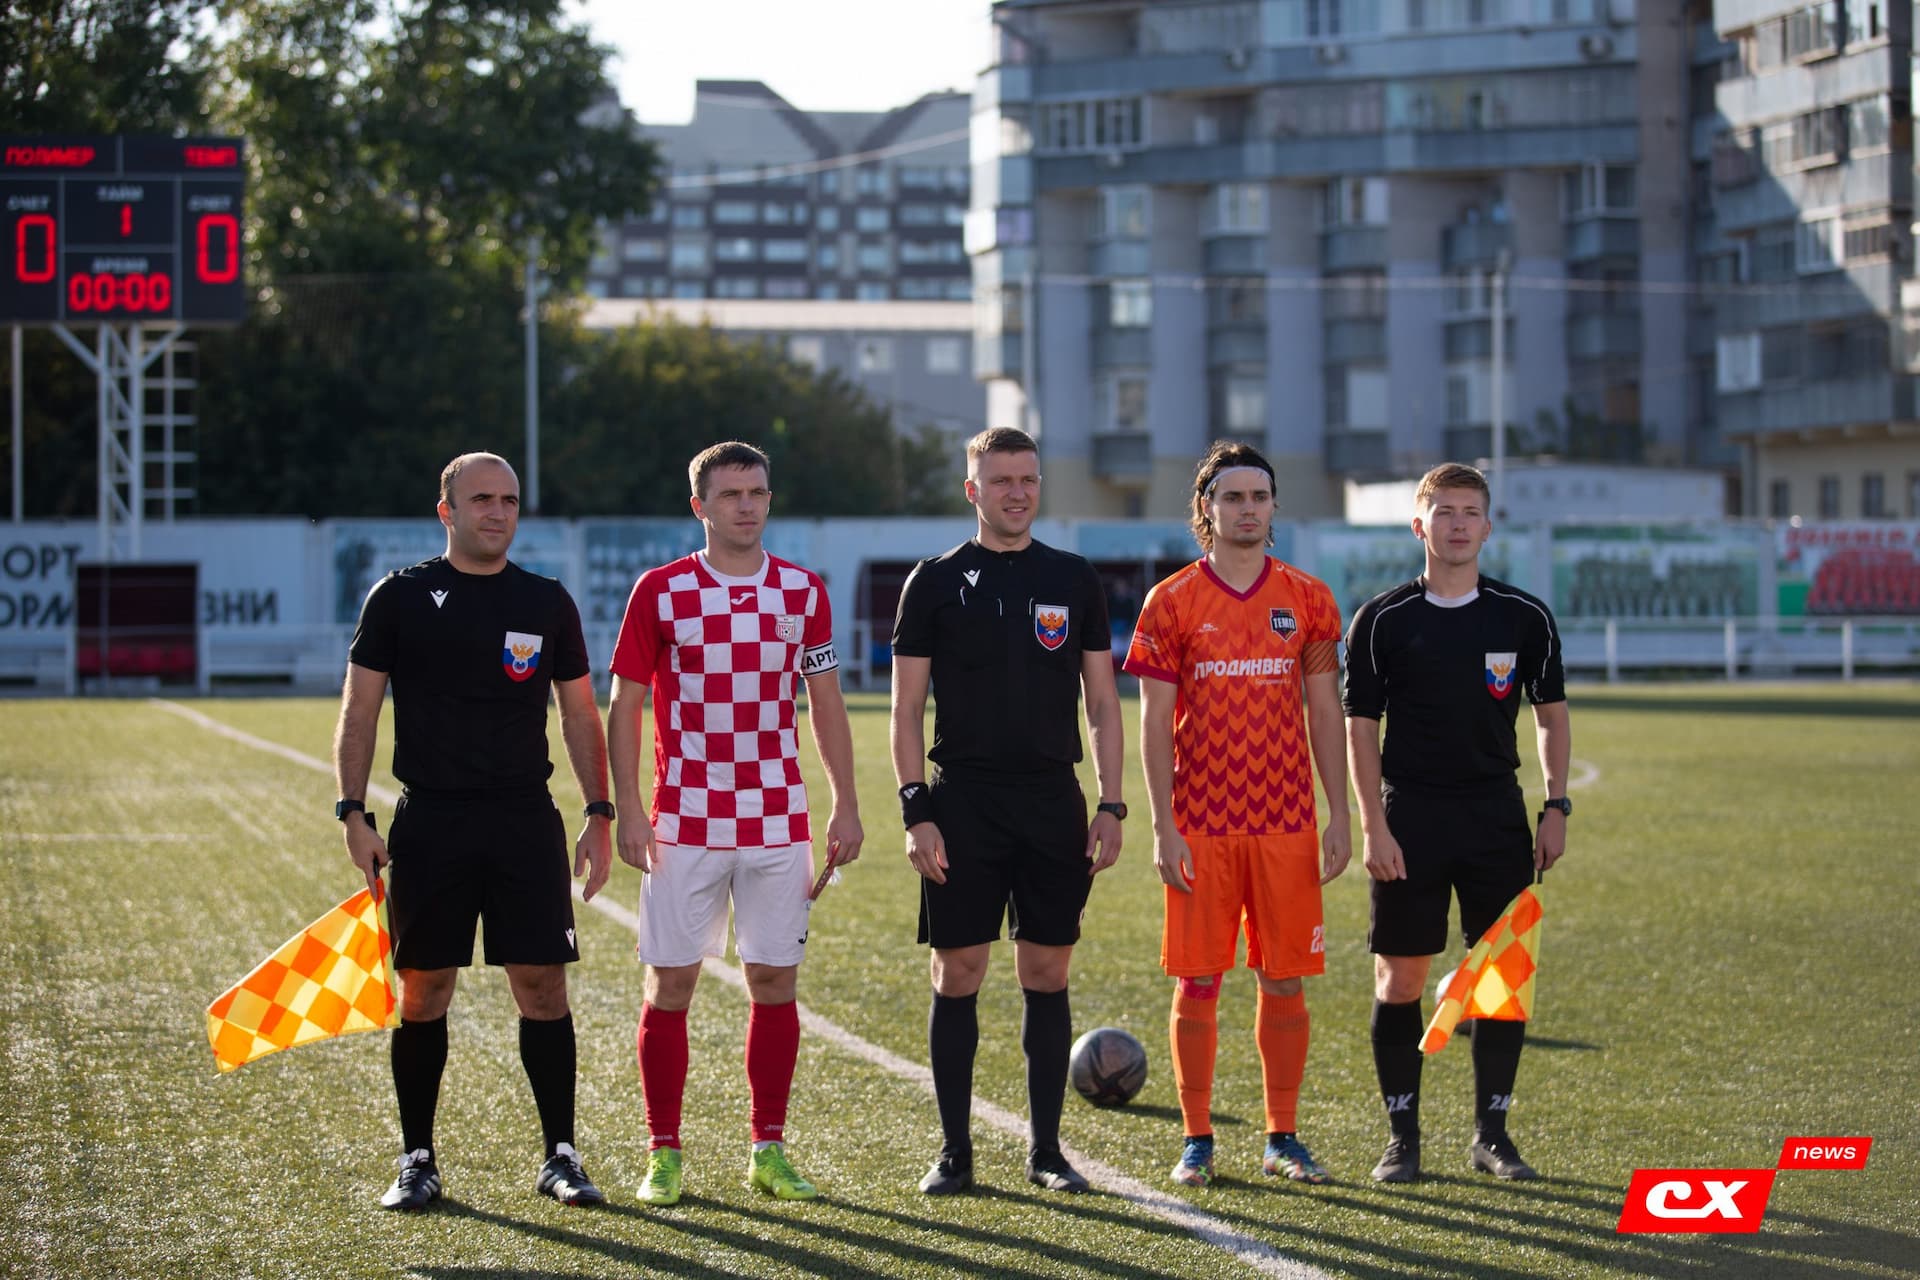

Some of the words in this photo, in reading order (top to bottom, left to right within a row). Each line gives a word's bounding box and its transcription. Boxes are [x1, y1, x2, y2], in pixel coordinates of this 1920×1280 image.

[120, 203, 133, 237] 1
[16, 213, 56, 283] 0
[196, 213, 239, 284] 0
[68, 272, 171, 312] 00:00
[1194, 658, 1295, 680] ПРОДИНВЕСТ
